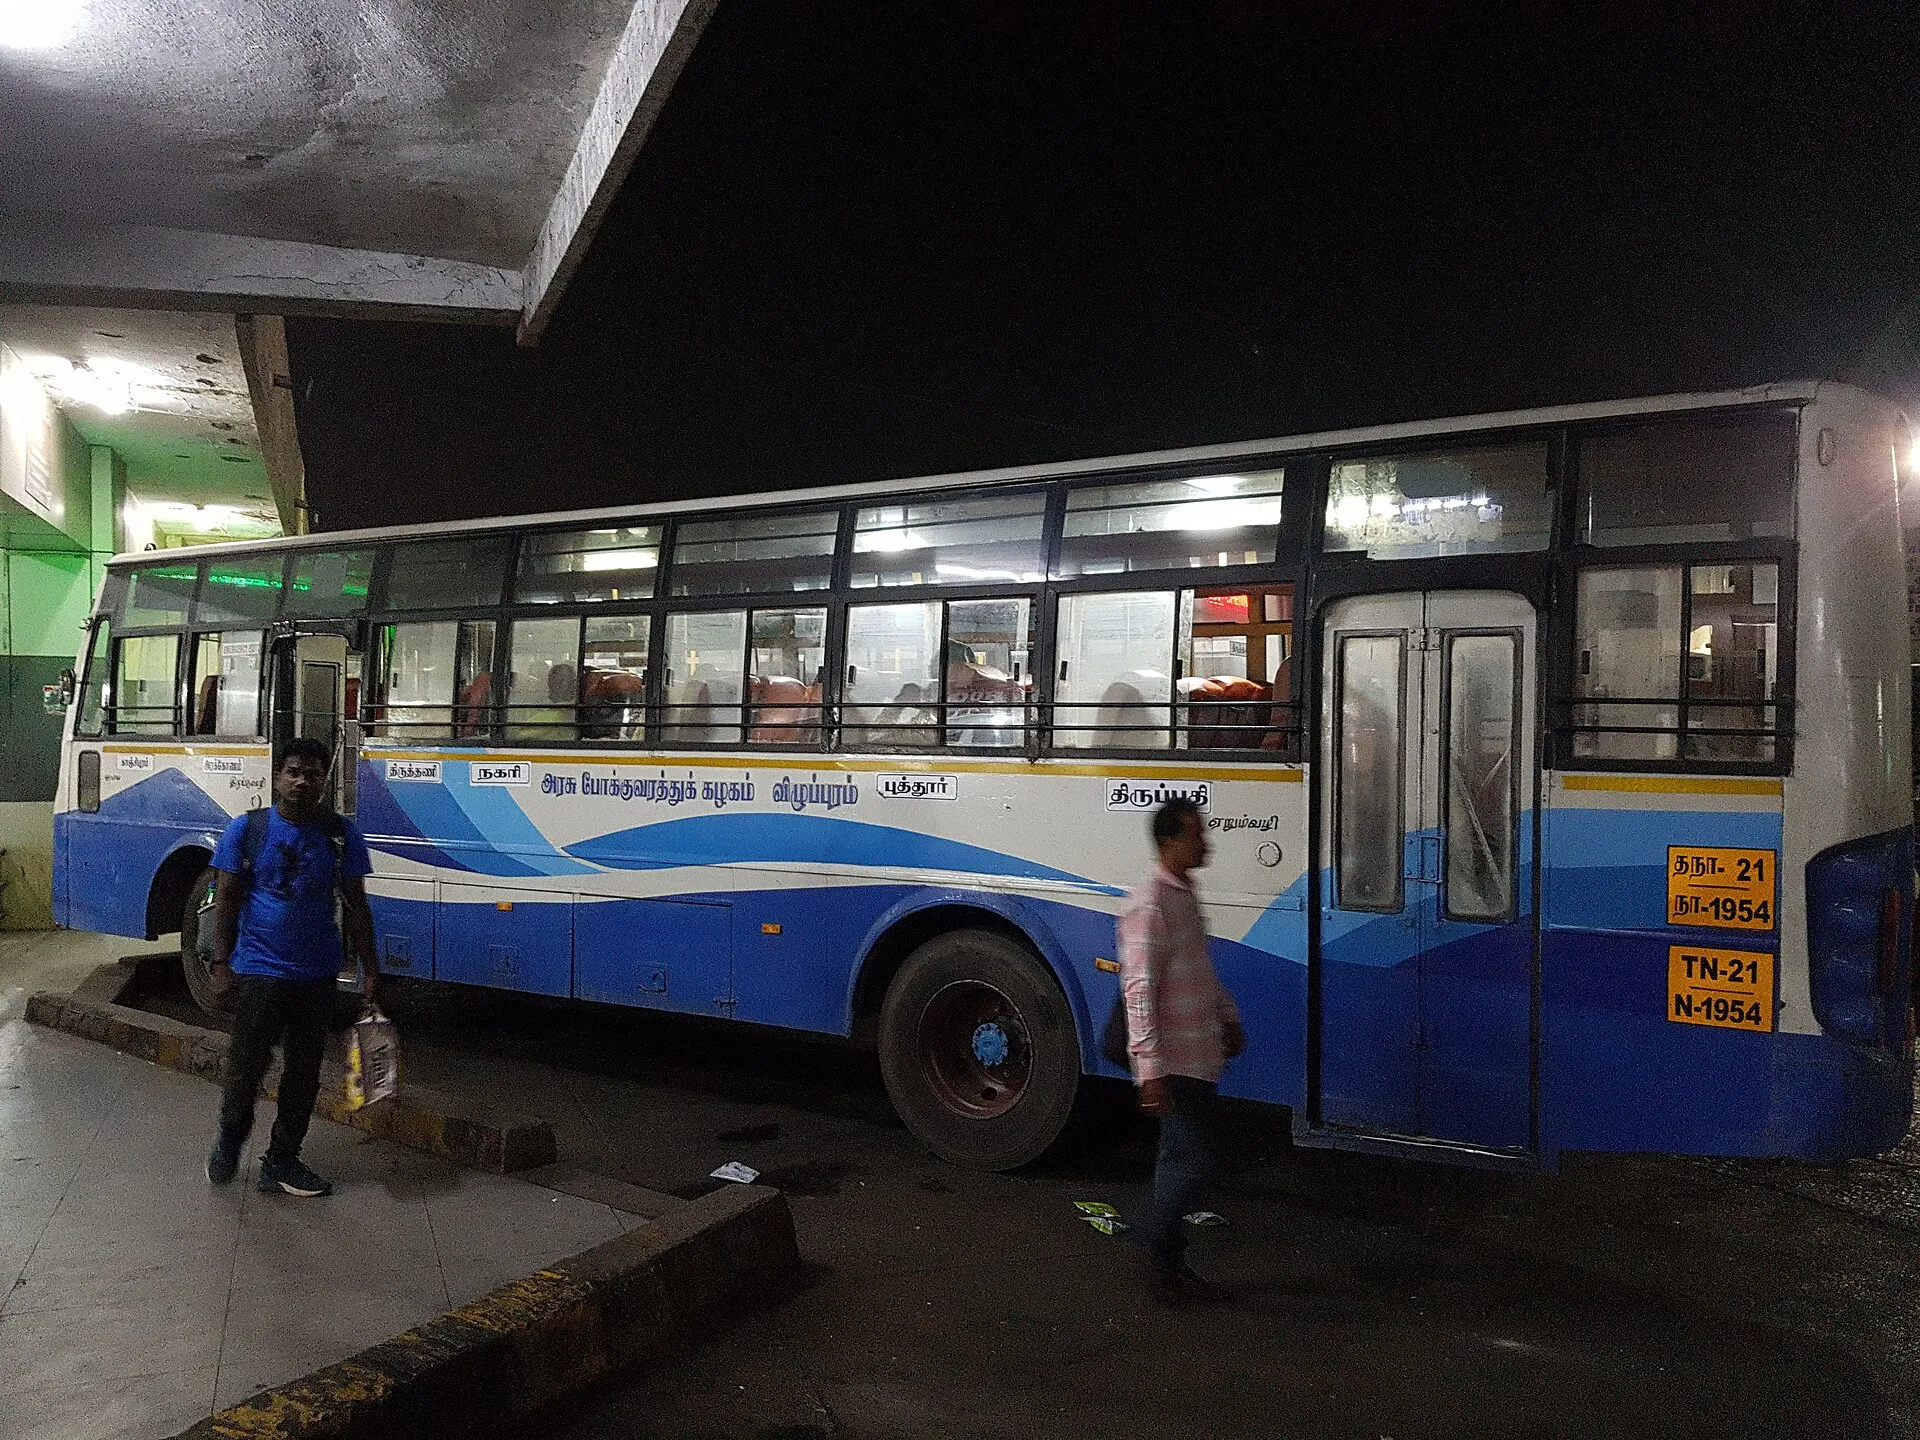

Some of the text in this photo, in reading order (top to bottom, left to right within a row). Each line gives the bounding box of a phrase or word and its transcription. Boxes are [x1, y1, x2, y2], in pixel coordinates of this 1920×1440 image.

[541, 768, 859, 811] அரசு போக்குவரத்துக் கழகம் விழுப்புரம்
[884, 775, 949, 797] புத்தூர்
[1109, 782, 1209, 807] திருப்பதி
[1736, 857, 1765, 882] 21
[1681, 954, 1759, 985] TN-21
[1674, 993, 1762, 1026] N-1954
